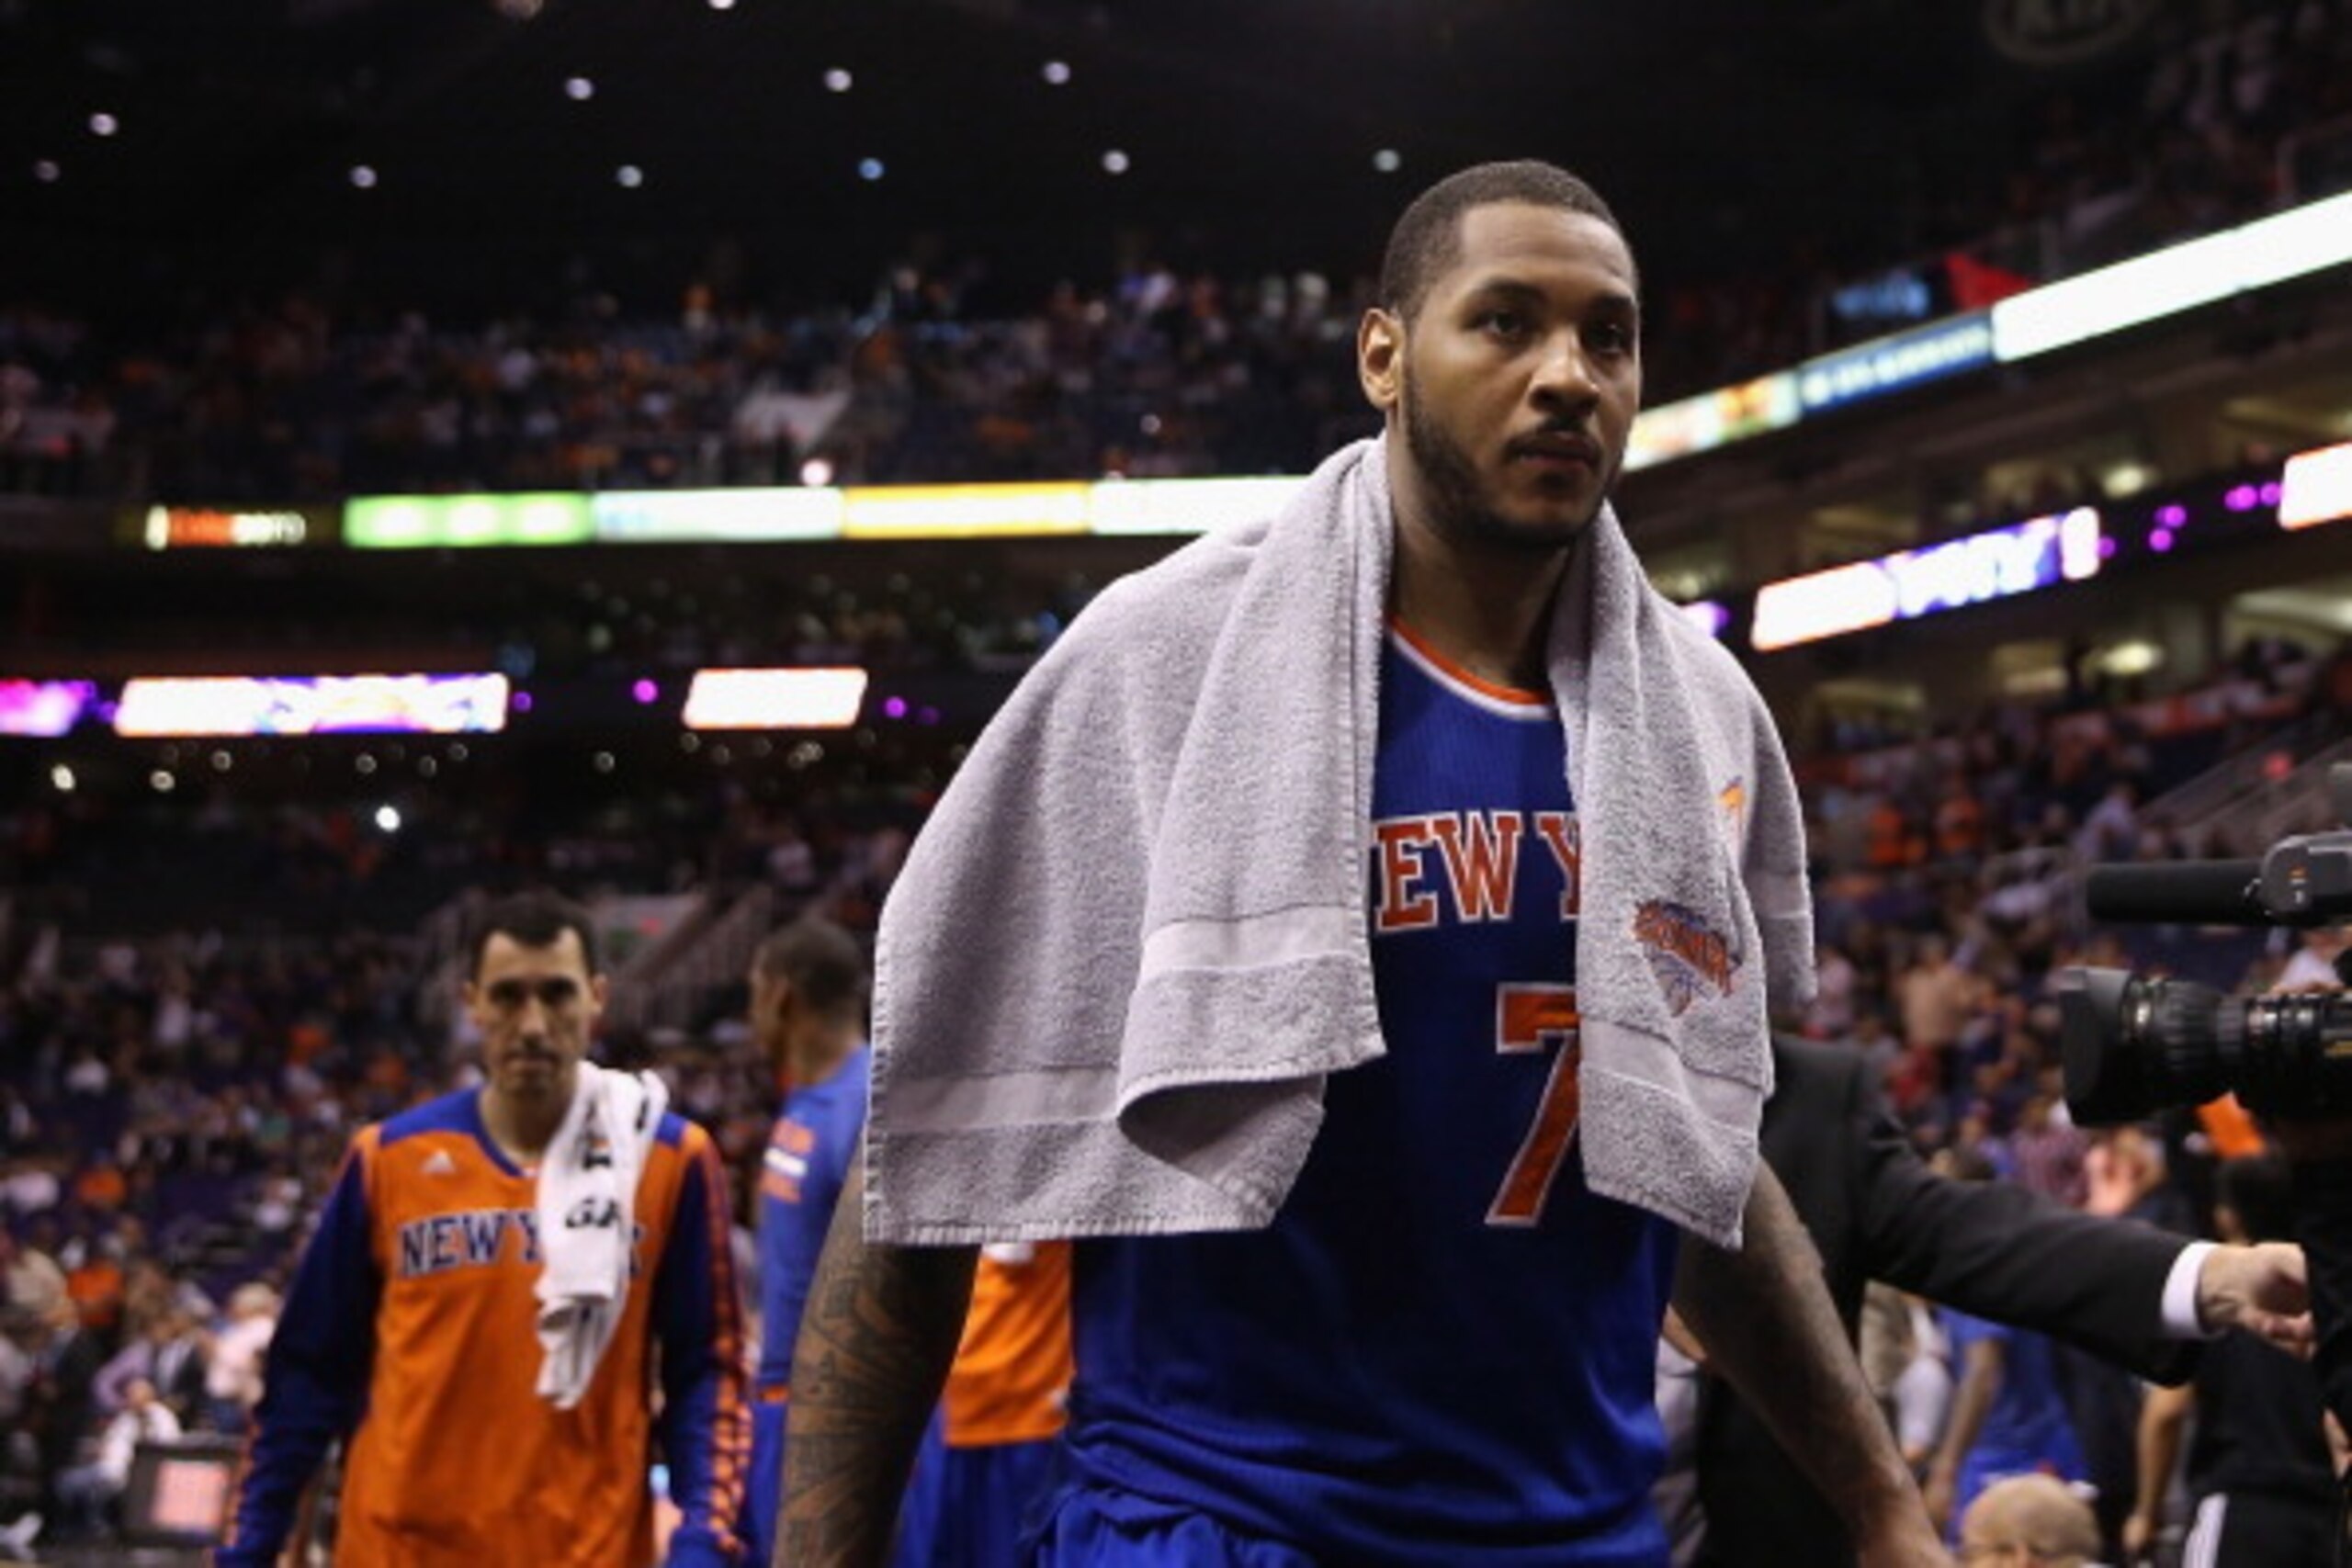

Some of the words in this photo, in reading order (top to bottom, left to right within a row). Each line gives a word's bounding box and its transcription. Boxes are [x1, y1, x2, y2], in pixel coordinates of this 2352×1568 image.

[1370, 810, 1521, 932] EW
[1532, 811, 1581, 923] Y
[1485, 983, 1581, 1226] 7
[399, 1210, 507, 1278] NEW
